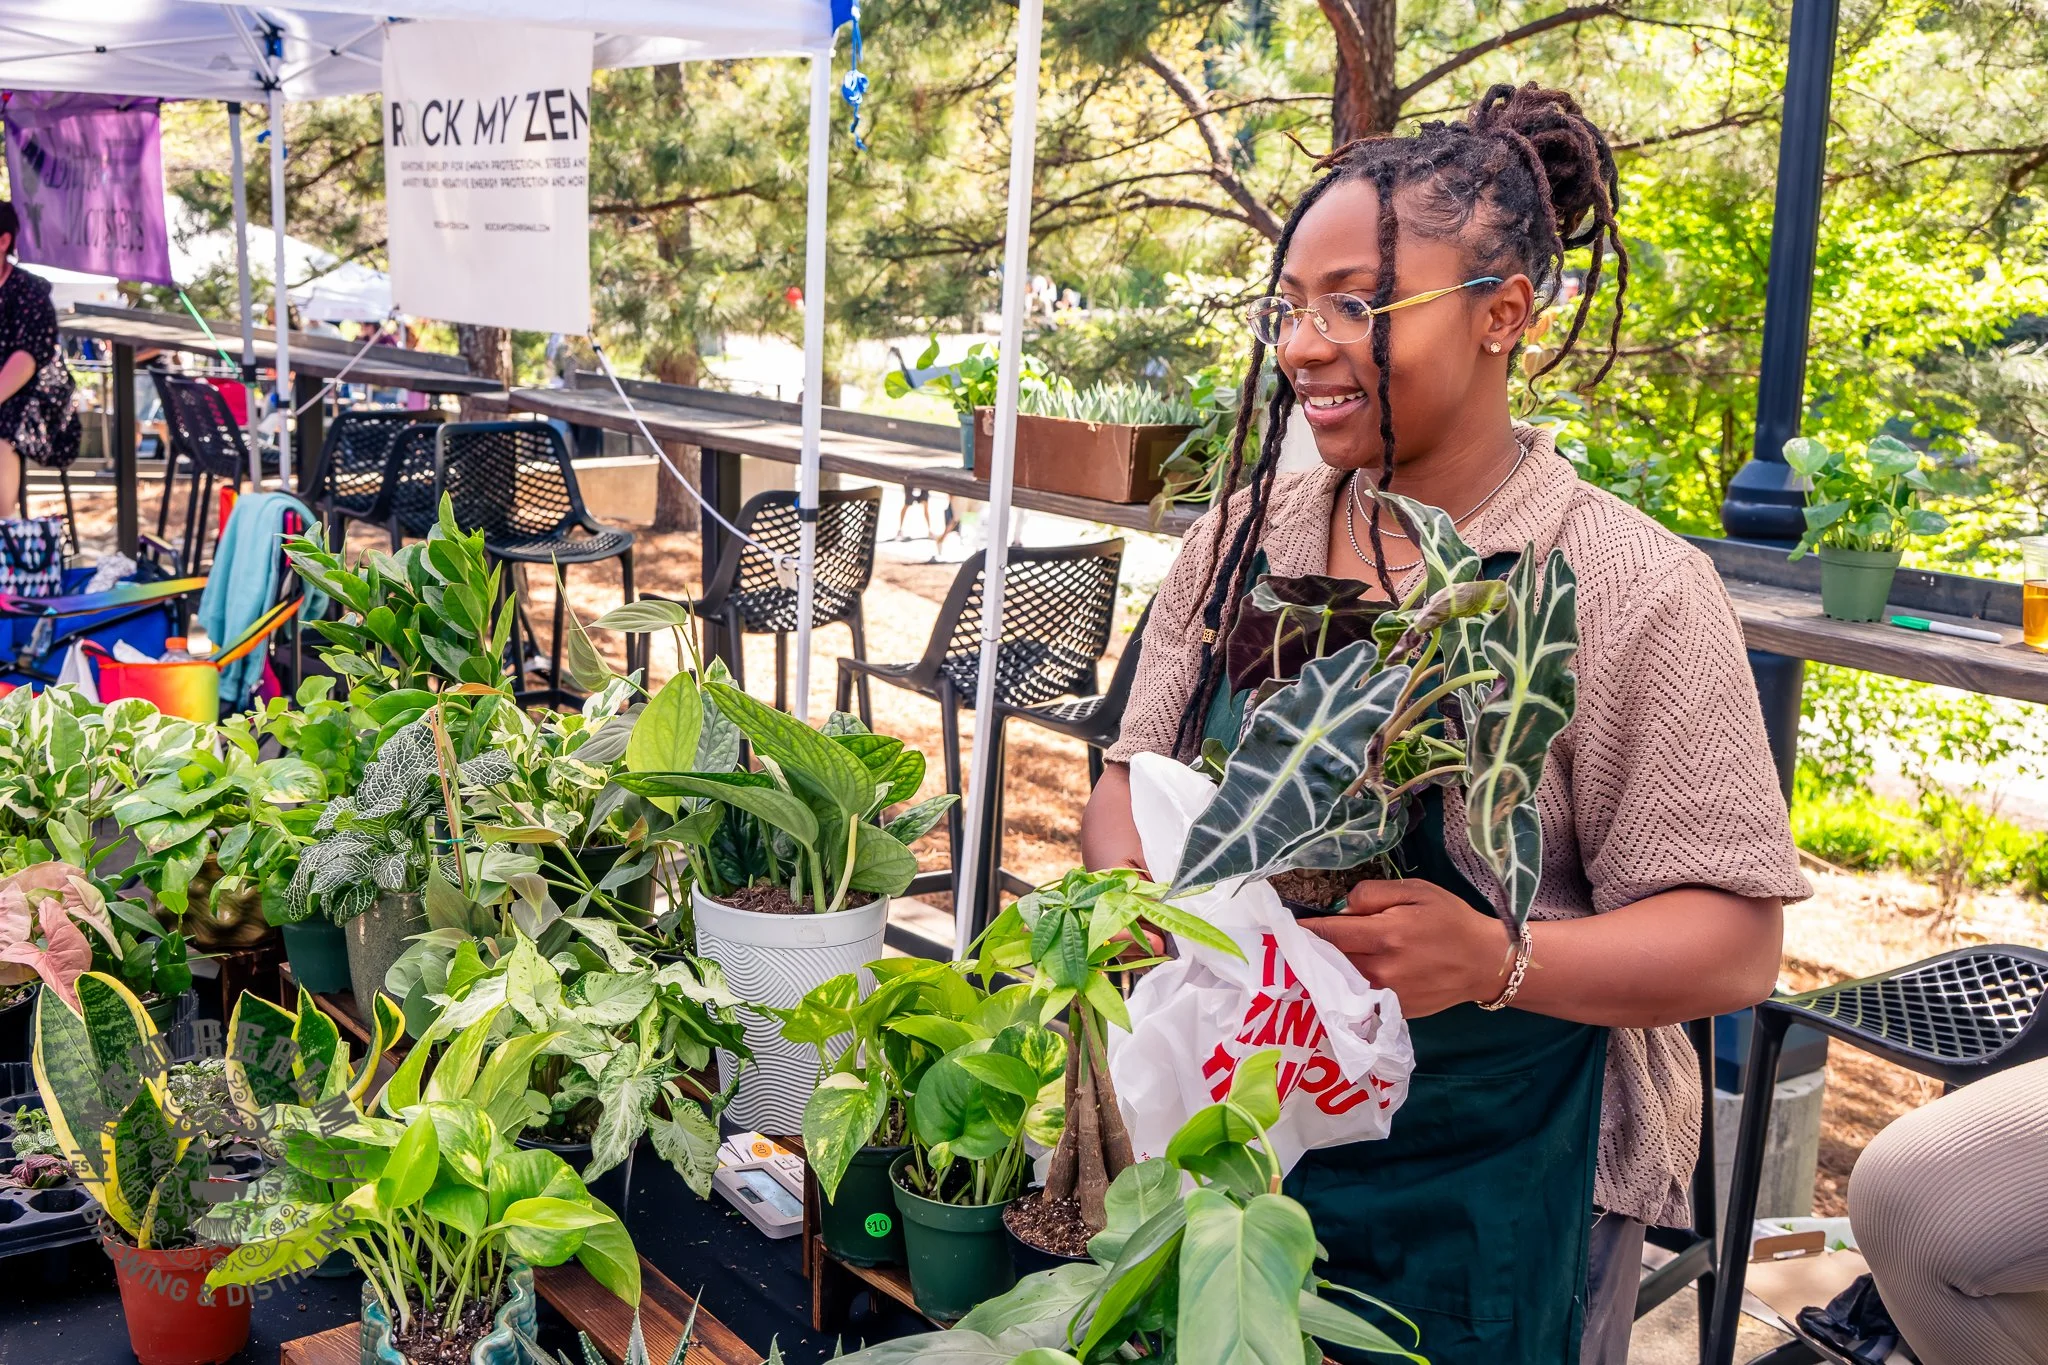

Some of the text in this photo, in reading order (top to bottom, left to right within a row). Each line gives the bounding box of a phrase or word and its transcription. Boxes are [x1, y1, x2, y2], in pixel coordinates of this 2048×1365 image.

[391, 87, 590, 146] ROCK MY ZEN
[500, 176, 548, 189] PROTECTION
[866, 1219, 888, 1233] $10
